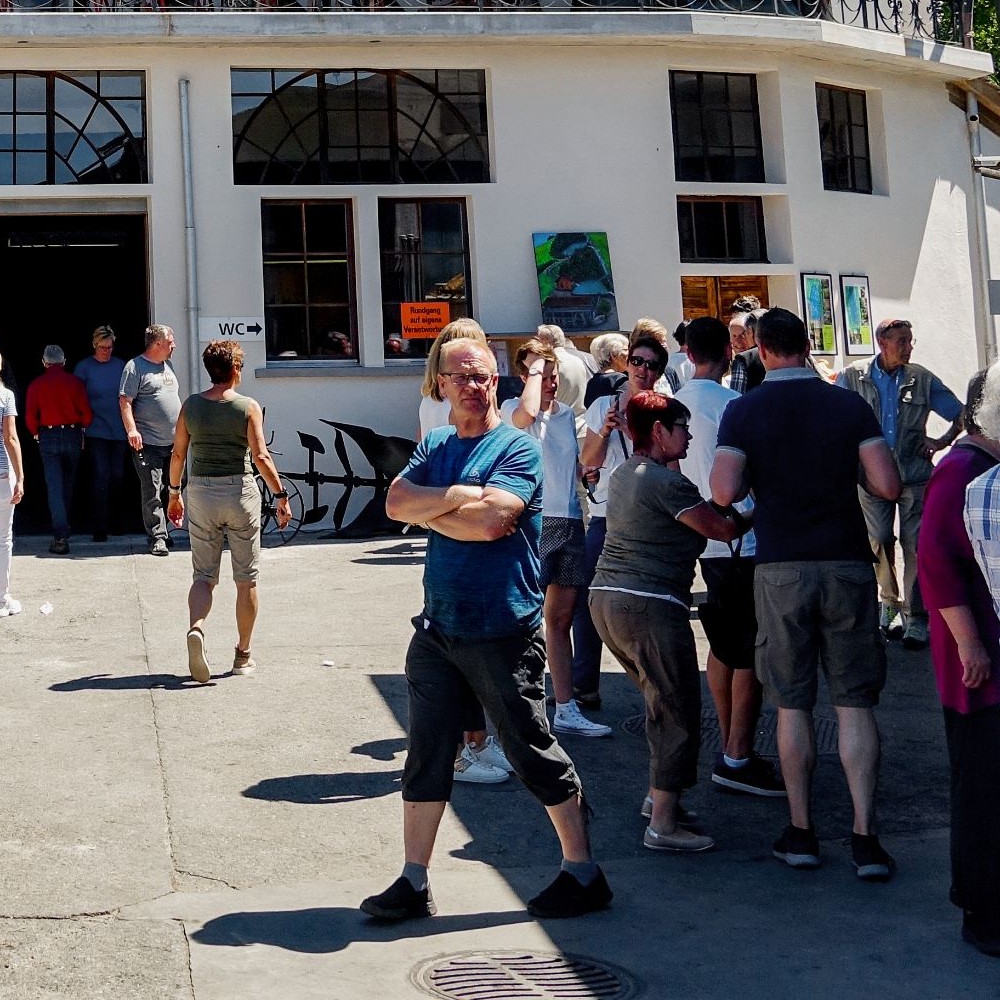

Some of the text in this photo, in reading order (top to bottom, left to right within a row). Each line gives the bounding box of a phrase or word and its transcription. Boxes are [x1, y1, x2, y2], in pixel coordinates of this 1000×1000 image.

[410, 306, 441, 315] Rundgang
[422, 316, 442, 325] eigene
[218, 322, 245, 336] WC
[403, 325, 444, 333] Verantwortu
